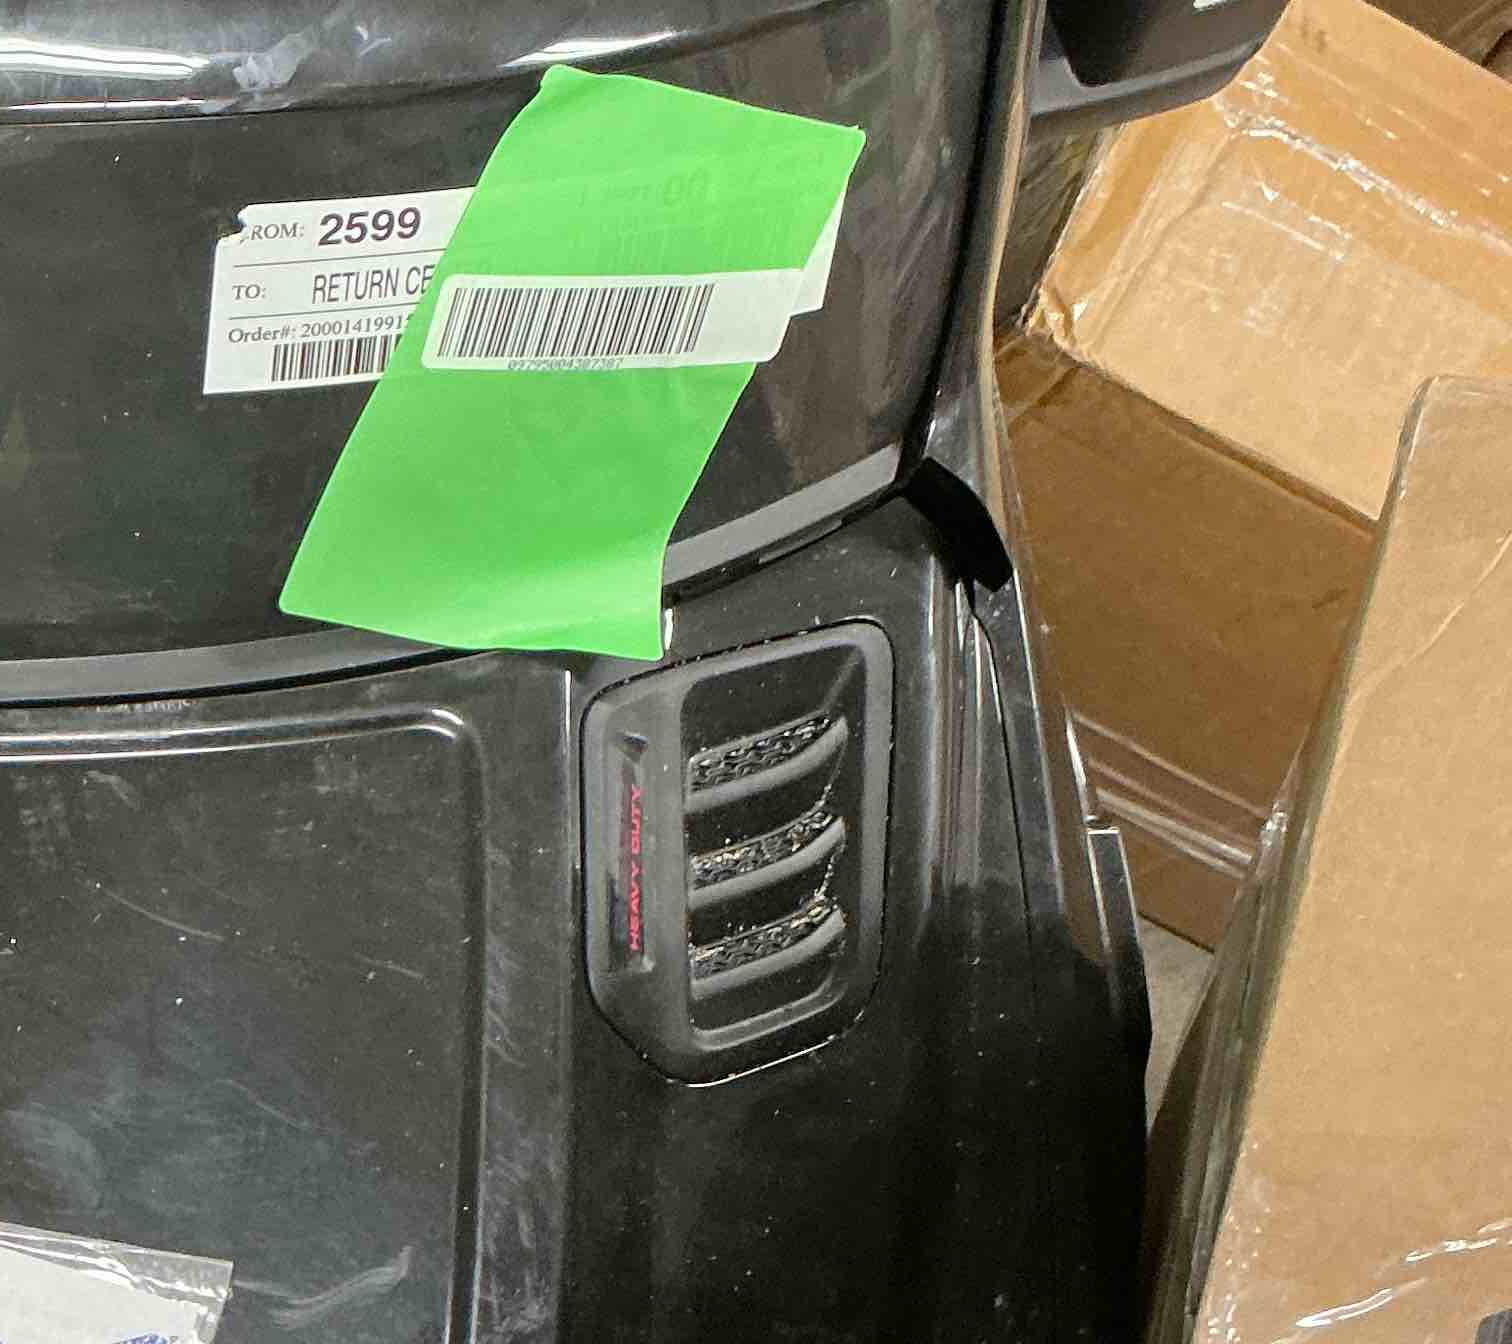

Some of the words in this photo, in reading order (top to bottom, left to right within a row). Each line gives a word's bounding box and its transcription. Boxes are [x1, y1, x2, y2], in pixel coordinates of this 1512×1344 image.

[245, 222, 305, 241] ROM:
[318, 207, 422, 247] 2599
[231, 283, 267, 301] TO:
[312, 265, 400, 305] RETURN
[228, 326, 297, 344] Order#:
[630, 785, 643, 855] DUTY
[629, 860, 644, 951] HEAVY
